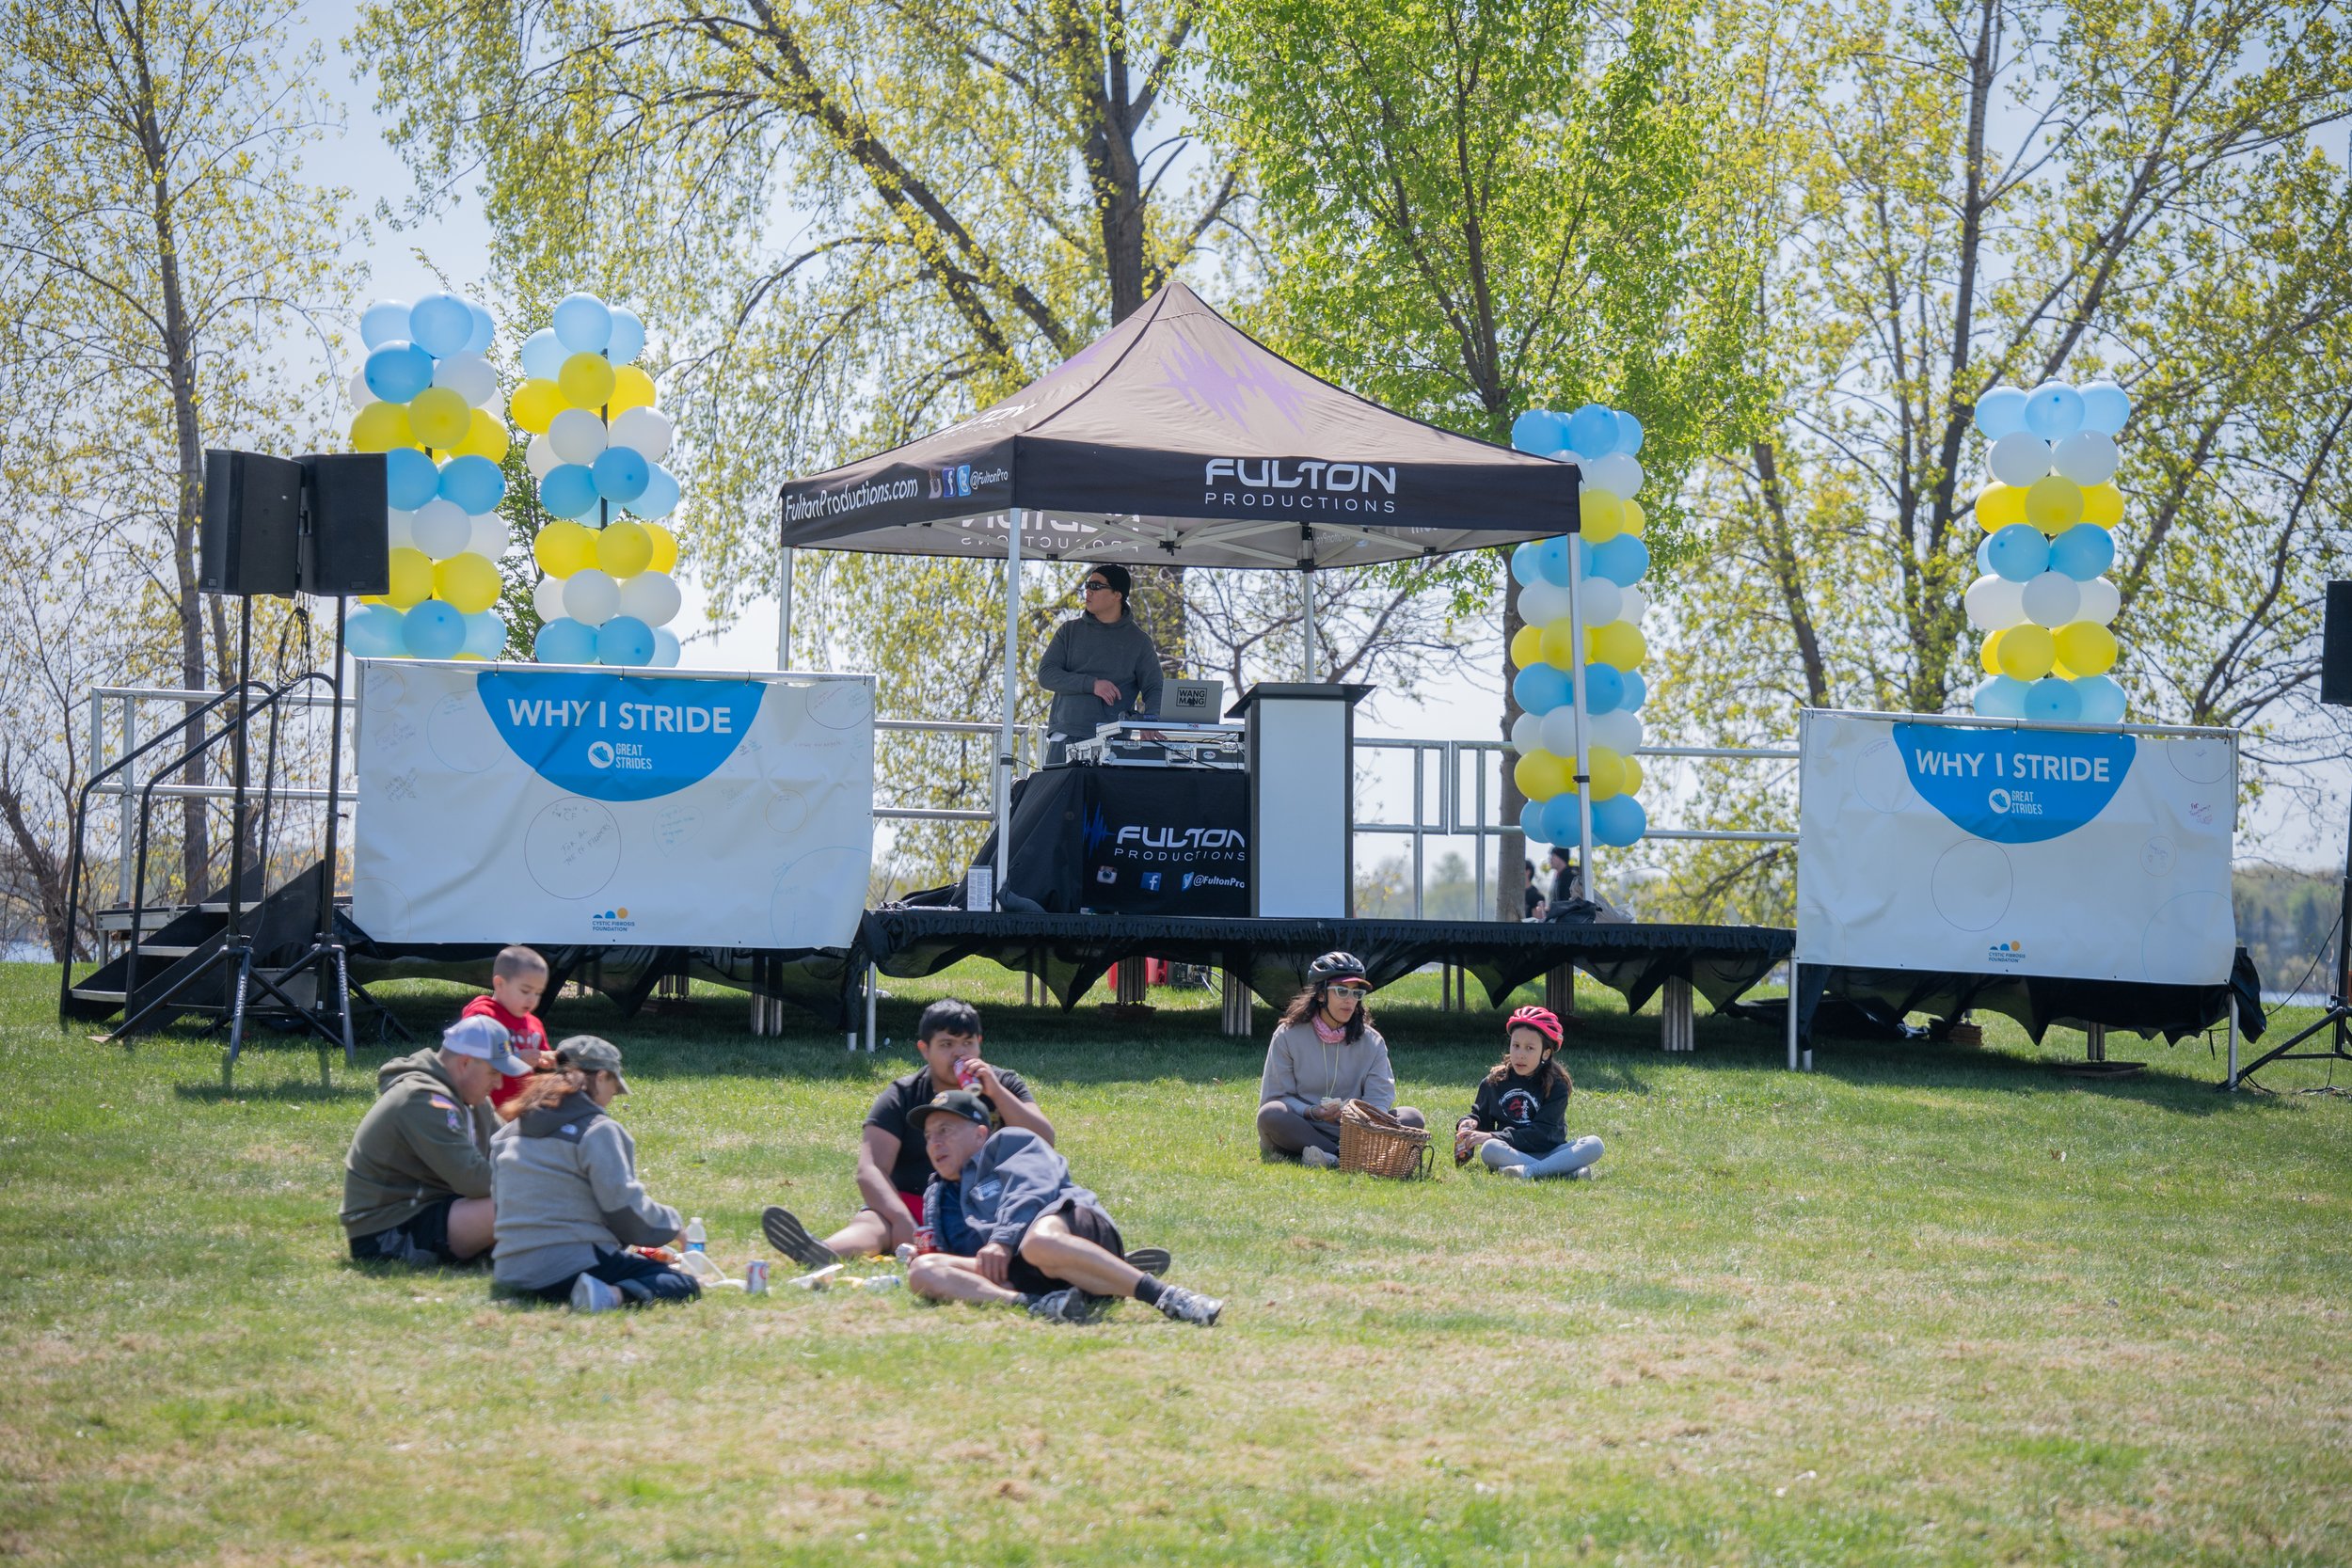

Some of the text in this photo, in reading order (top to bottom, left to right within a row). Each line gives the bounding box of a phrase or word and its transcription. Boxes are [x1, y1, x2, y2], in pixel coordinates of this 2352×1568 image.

[970, 469, 1009, 490] @FultonPro
[1205, 458, 1395, 495] FULTON
[786, 477, 918, 521] FultonProductions.com
[1205, 492, 1395, 514] PRODUCTIONS
[1178, 697, 1204, 705] MANG
[1179, 689, 1205, 698] WANG
[508, 698, 732, 735] WHY I STRIDE
[615, 742, 644, 757] GREAT
[615, 755, 653, 770] STRIDES
[1915, 749, 1984, 778] WHY
[1995, 752, 2003, 777] I
[2013, 753, 2110, 784] STRIDE
[2011, 789, 2034, 803] GREAT
[2011, 801, 2043, 816] STRIDES
[1116, 825, 1246, 848] FULTON
[1114, 847, 1246, 862] PRODUCTIONS
[1193, 875, 1246, 889] @FultonPro
